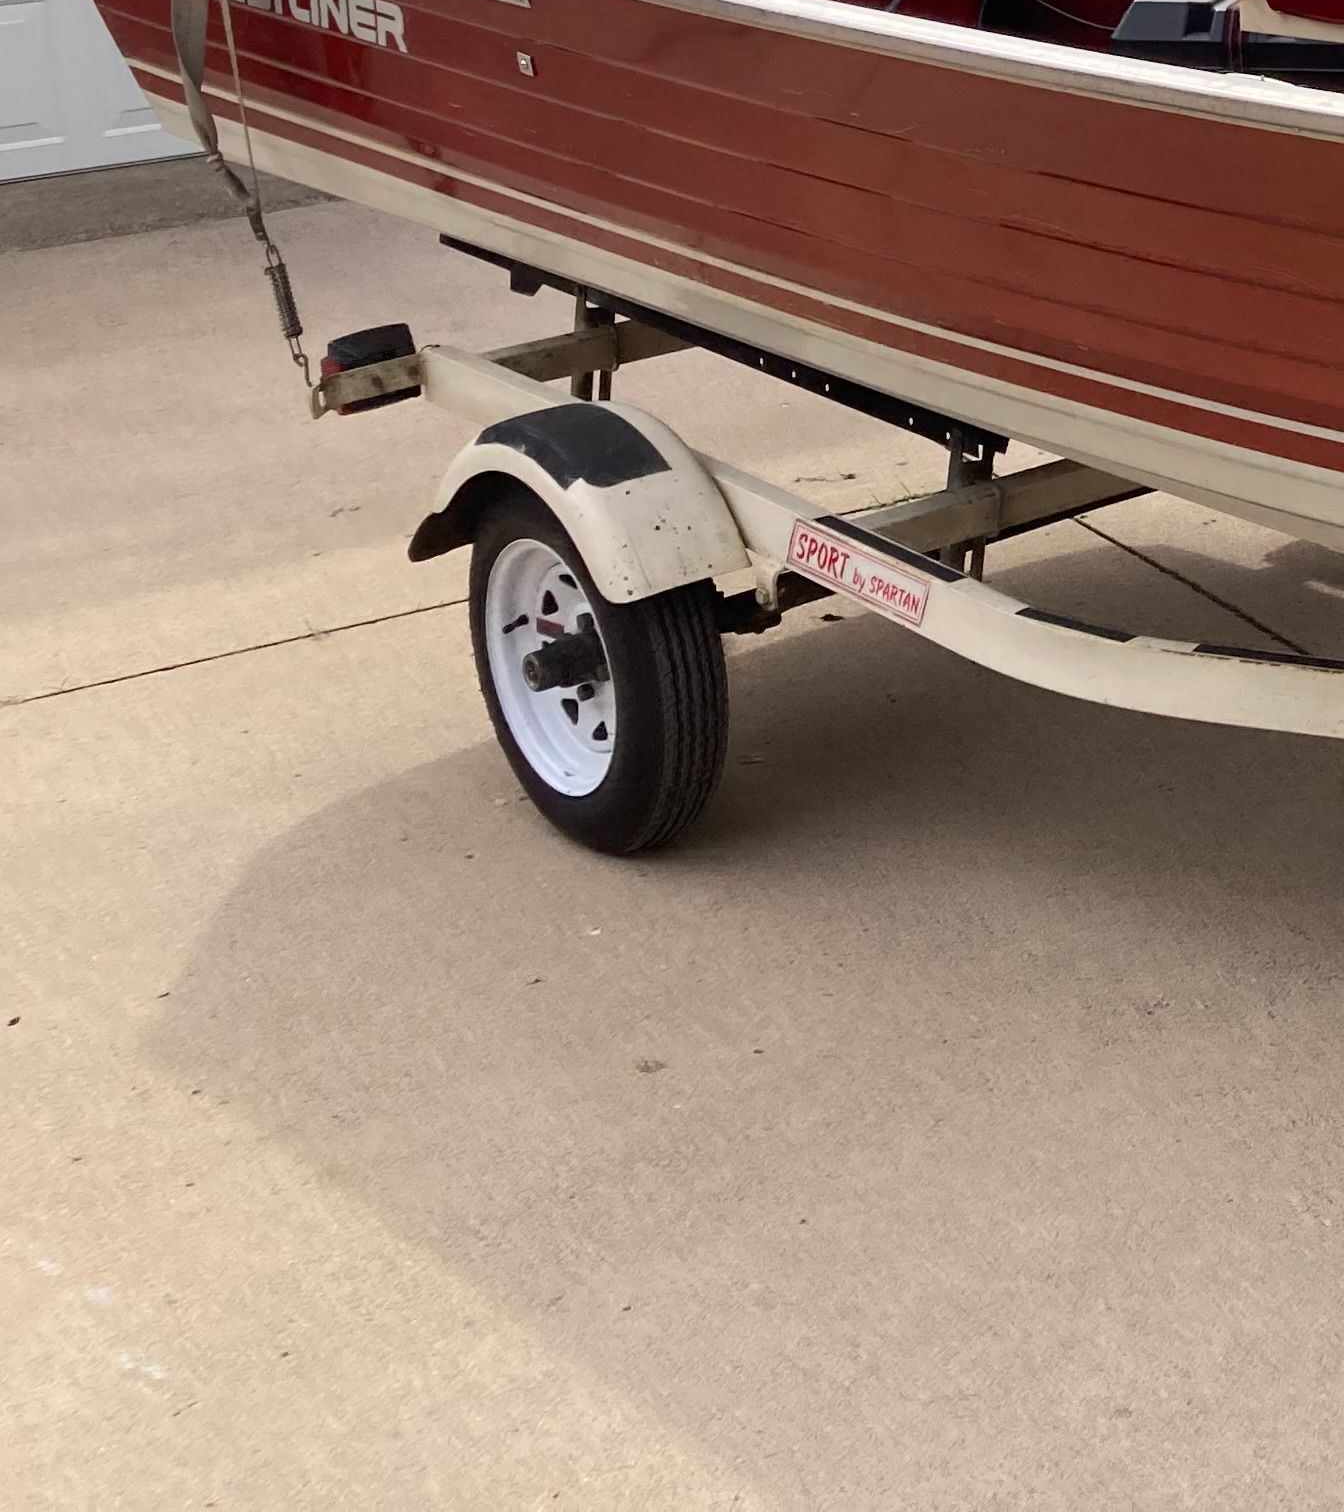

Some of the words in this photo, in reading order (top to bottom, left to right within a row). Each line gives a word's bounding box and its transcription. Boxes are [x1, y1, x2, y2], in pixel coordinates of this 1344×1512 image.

[796, 532, 850, 579] SPORT
[851, 567, 866, 593] by
[868, 574, 921, 615] SPARTAN
